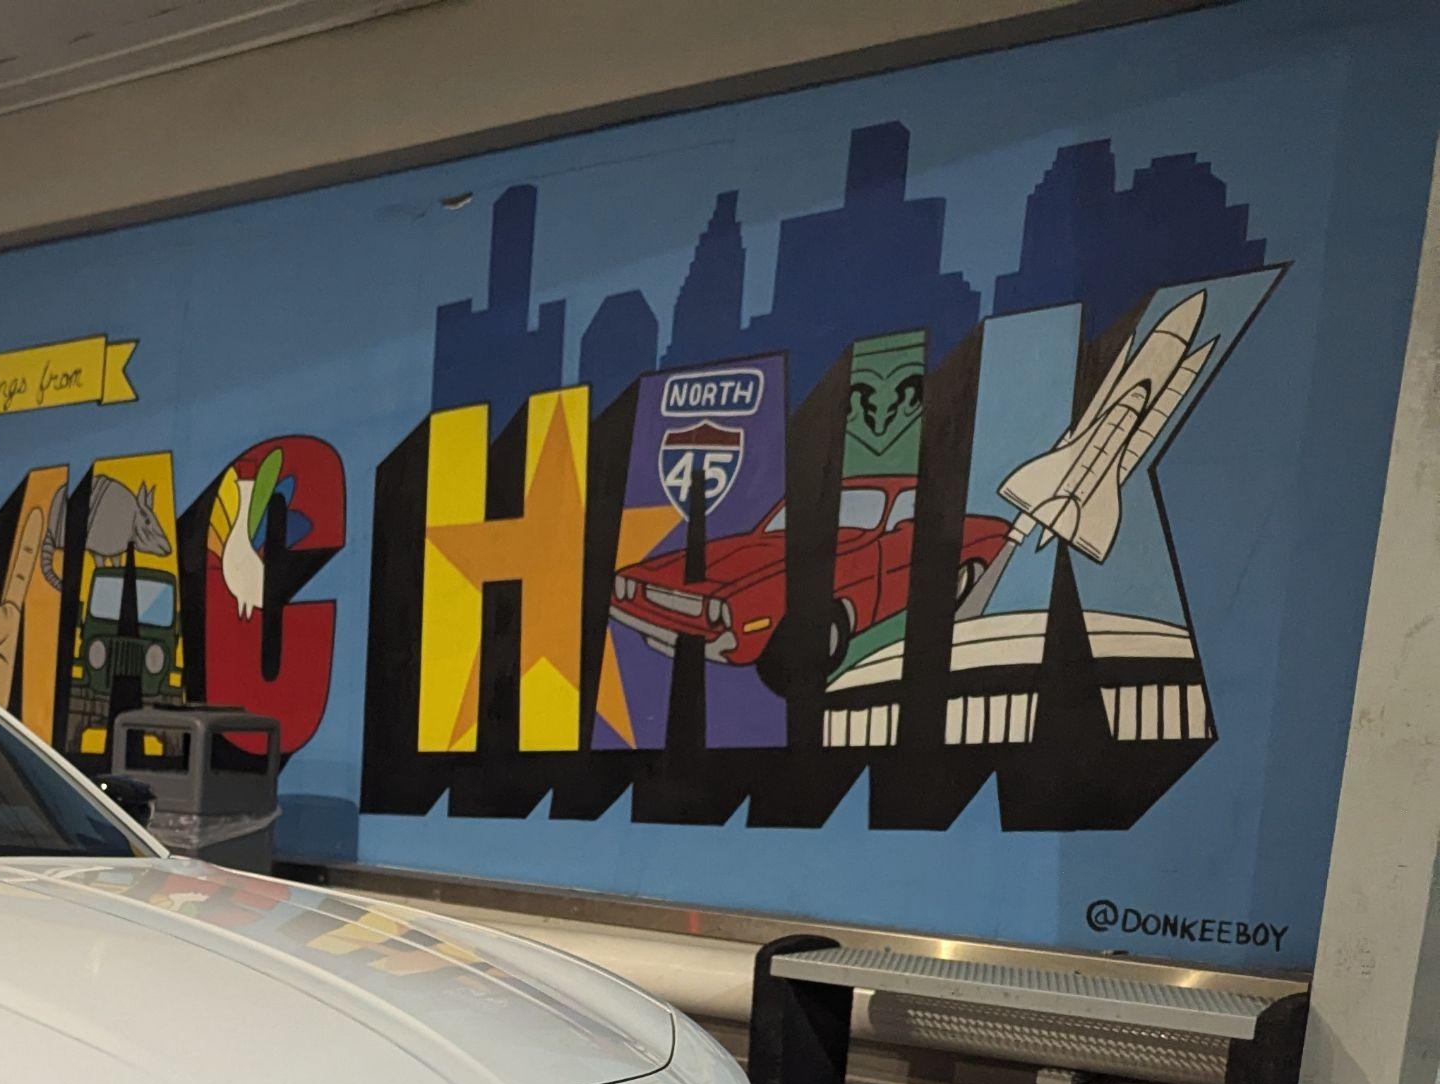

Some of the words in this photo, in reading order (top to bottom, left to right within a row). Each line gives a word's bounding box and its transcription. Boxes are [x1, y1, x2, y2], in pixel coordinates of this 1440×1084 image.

[36, 360, 83, 405] from
[668, 380, 755, 408] NORTH
[663, 451, 735, 503] 45
[415, 262, 1293, 755] HAIK
[1085, 899, 1290, 953] @DONKEEBOY
